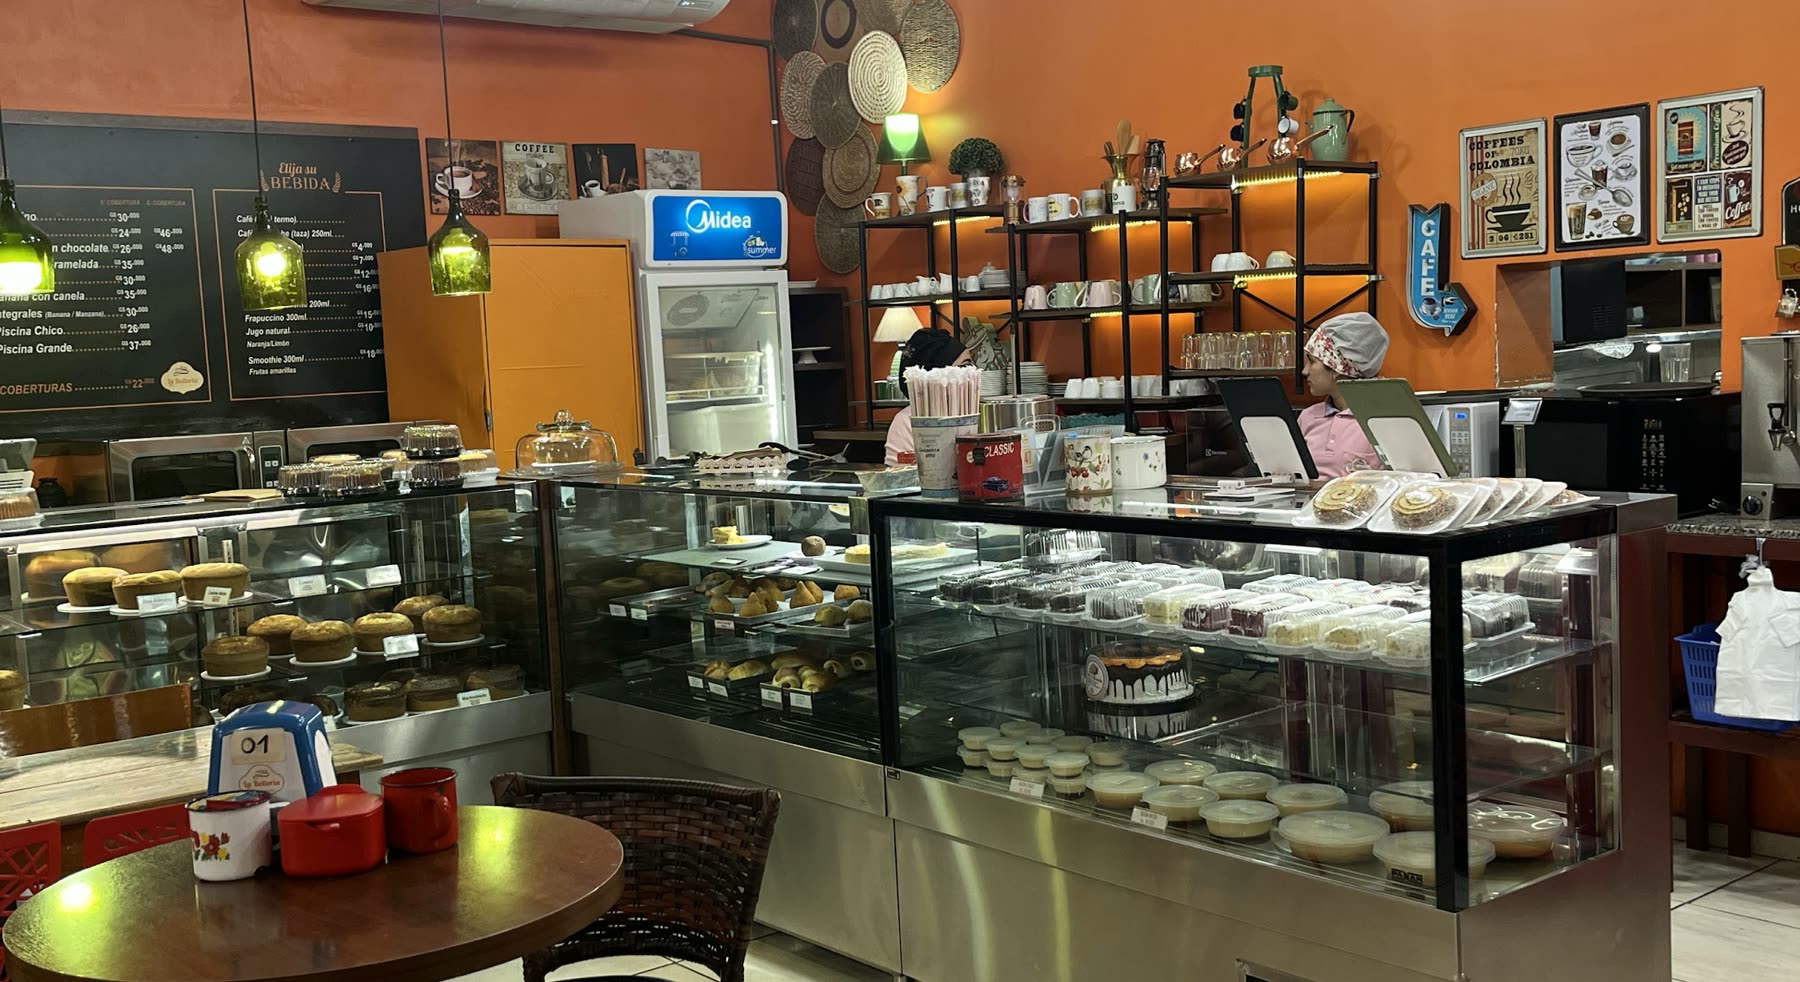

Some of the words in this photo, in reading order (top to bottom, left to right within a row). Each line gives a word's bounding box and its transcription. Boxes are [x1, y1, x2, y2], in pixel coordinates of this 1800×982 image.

[515, 143, 555, 153] COFFEE
[1469, 136, 1524, 151] COFFEES
[1485, 151, 1497, 159] OF
[1470, 155, 1535, 171] COLOMBIA
[279, 162, 303, 178] Elija
[305, 165, 317, 174] su
[271, 176, 330, 190] BEBIDA
[1725, 201, 1750, 220] Coffee
[274, 215, 297, 225] termo)
[690, 202, 752, 230] Midea
[291, 229, 310, 239] (taza)
[311, 229, 332, 238] 250ml
[61, 243, 109, 253] chocolate
[748, 246, 776, 254] summer
[1420, 219, 1436, 296] CAFE
[54, 259, 99, 269] ramelada
[32, 293, 50, 301] con
[53, 291, 85, 301] canela
[309, 300, 330, 308] 200ml
[0, 309, 42, 321] tegrales
[245, 314, 284, 323] Frapuccino
[34, 325, 64, 335] Chico
[245, 328, 264, 337] Jugo
[265, 327, 291, 335] natural
[36, 342, 73, 353] Grande
[248, 356, 282, 365] Smoothie
[0, 382, 73, 395] COBERTURAS
[984, 441, 1015, 458] CLASSIC
[241, 734, 270, 754] 01
